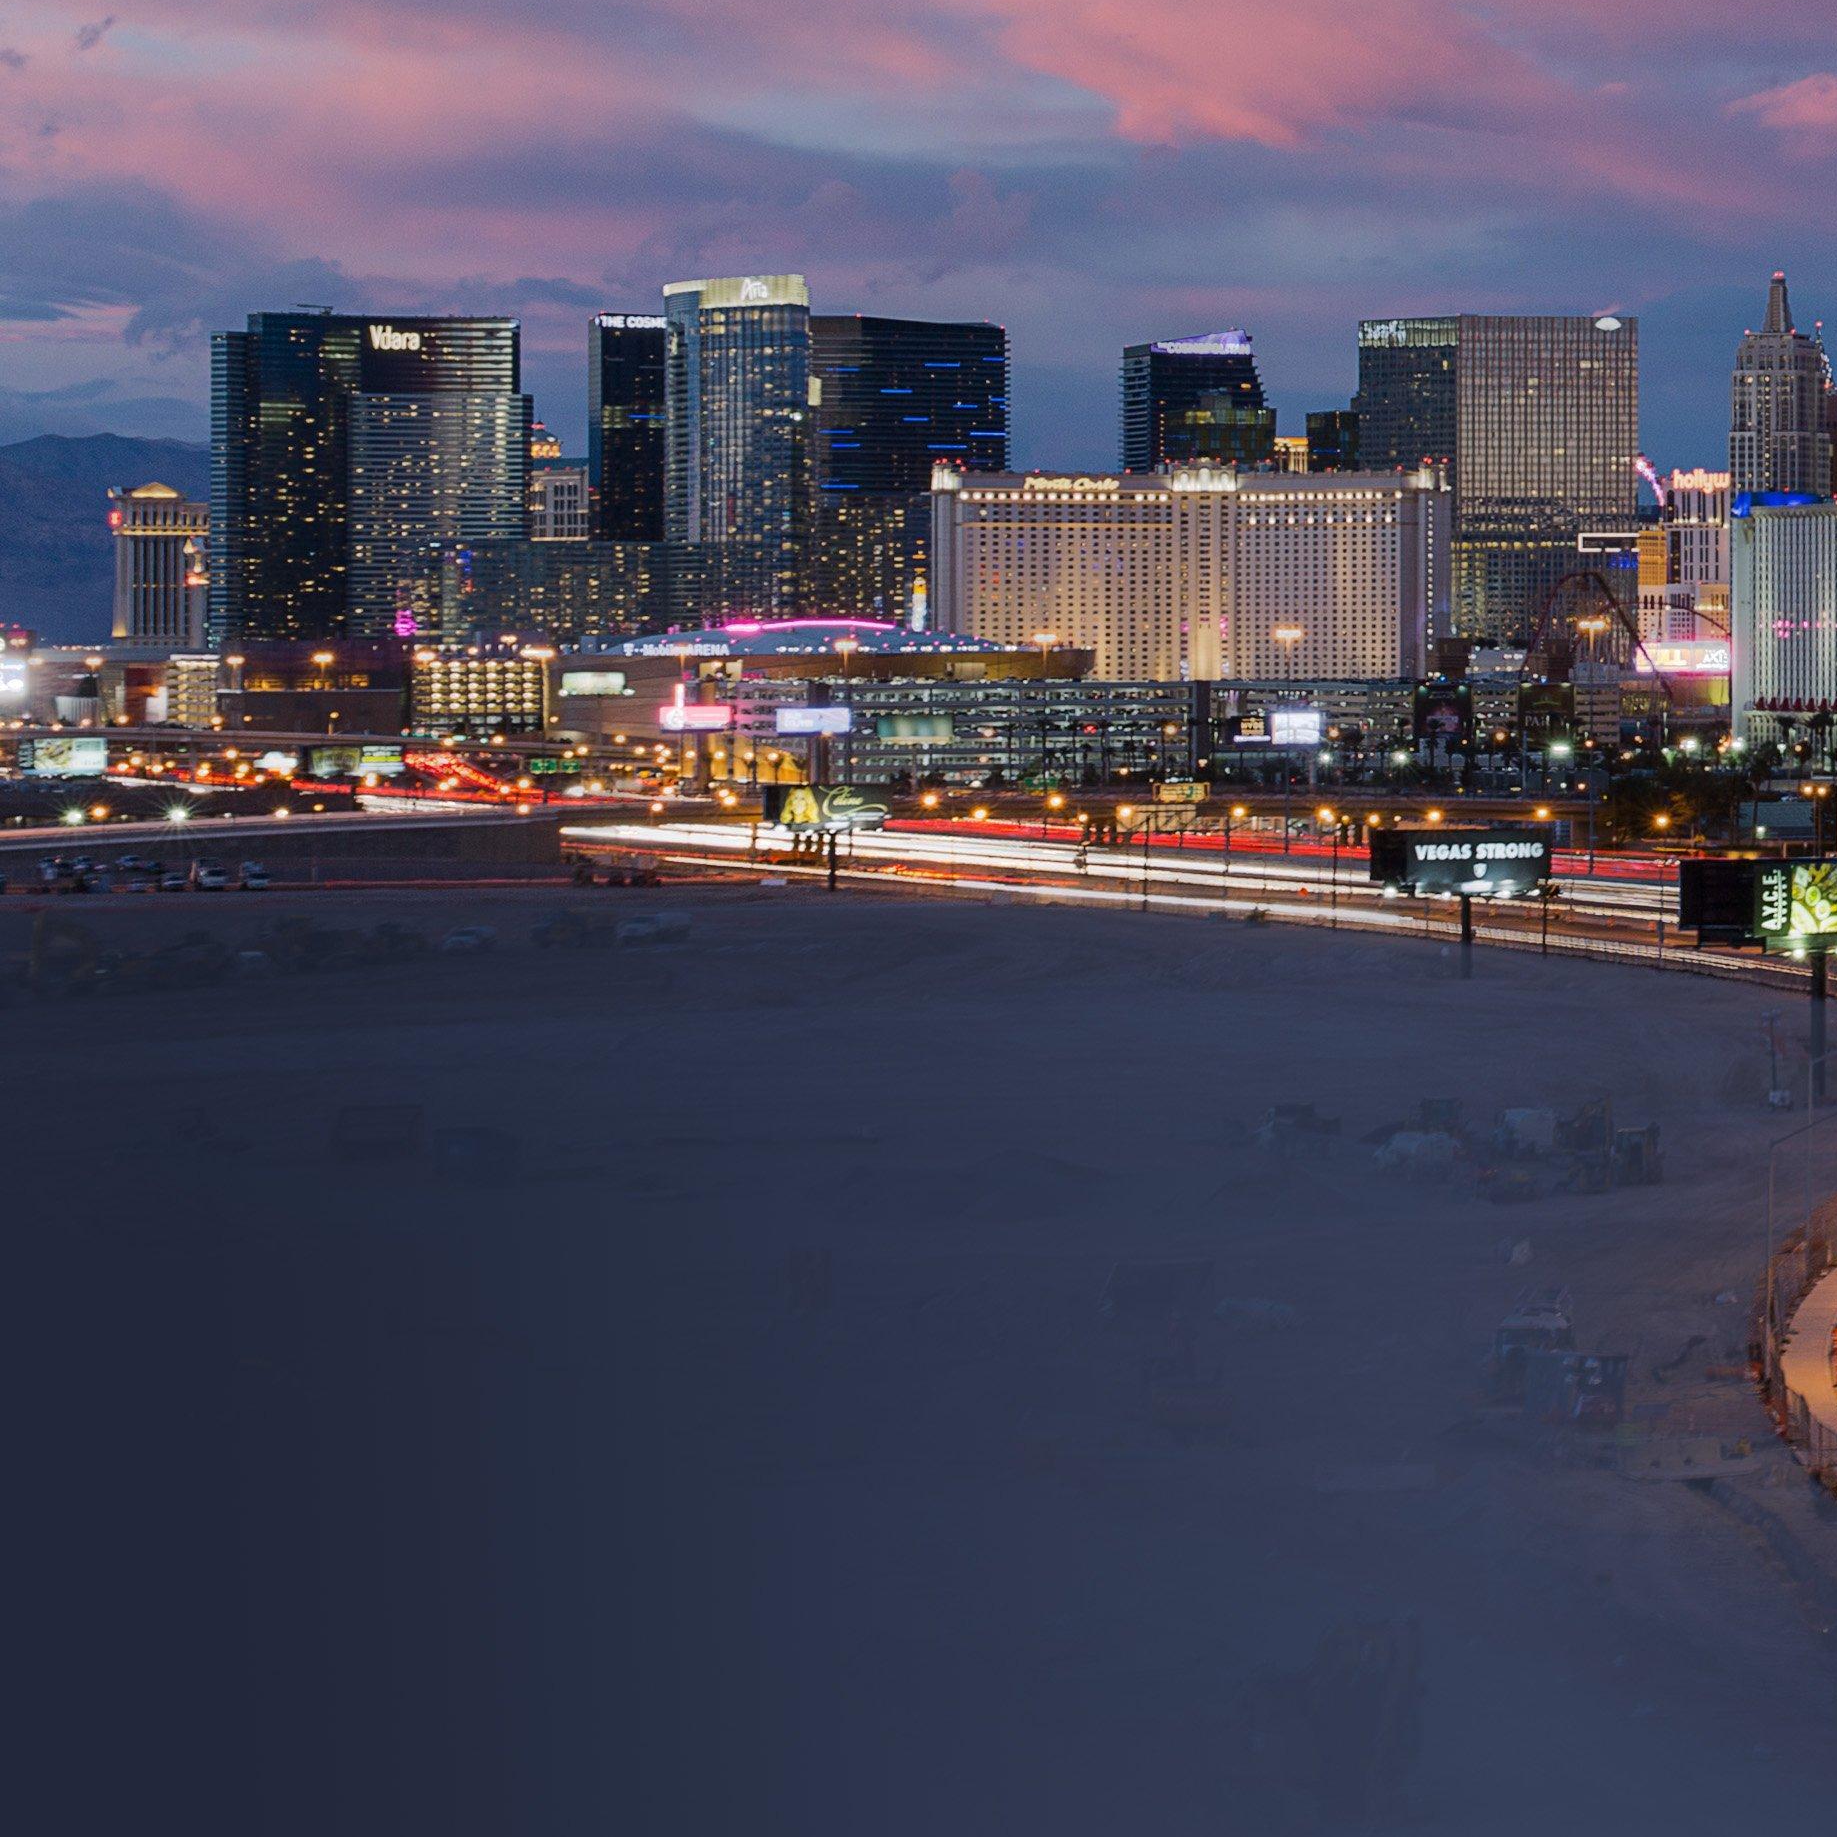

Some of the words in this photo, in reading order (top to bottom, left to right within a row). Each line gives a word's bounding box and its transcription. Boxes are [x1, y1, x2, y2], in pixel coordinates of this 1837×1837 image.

[369, 325, 420, 351] Vdara
[688, 644, 730, 656] ARENA
[1415, 844, 1472, 861] VEGAS
[1476, 842, 1544, 860] STRONG
